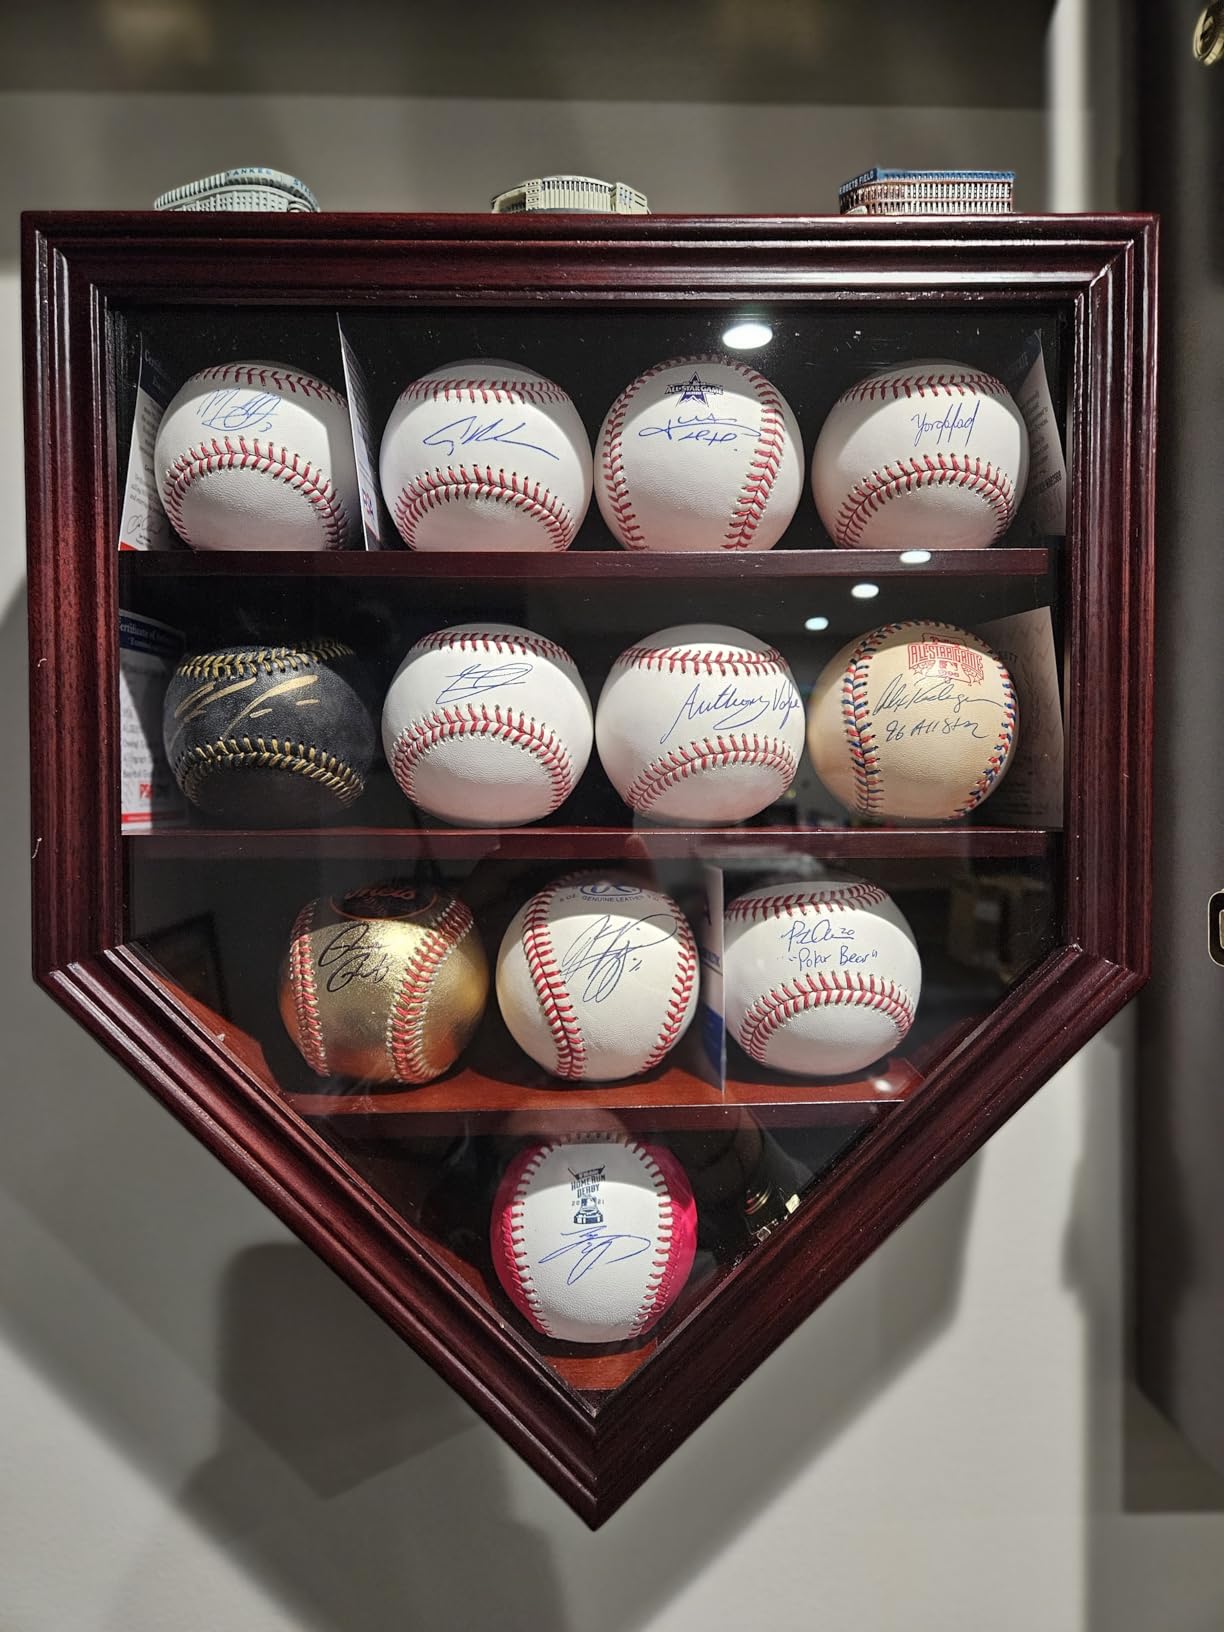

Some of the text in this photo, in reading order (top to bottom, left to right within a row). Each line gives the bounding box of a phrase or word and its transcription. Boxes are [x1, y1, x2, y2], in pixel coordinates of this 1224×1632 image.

[700, 384, 724, 396] GAME
[583, 895, 614, 903] GENUINE
[570, 1177, 590, 1191] HOME
[591, 1173, 606, 1184] RUN
[577, 1183, 600, 1198] DERBY
